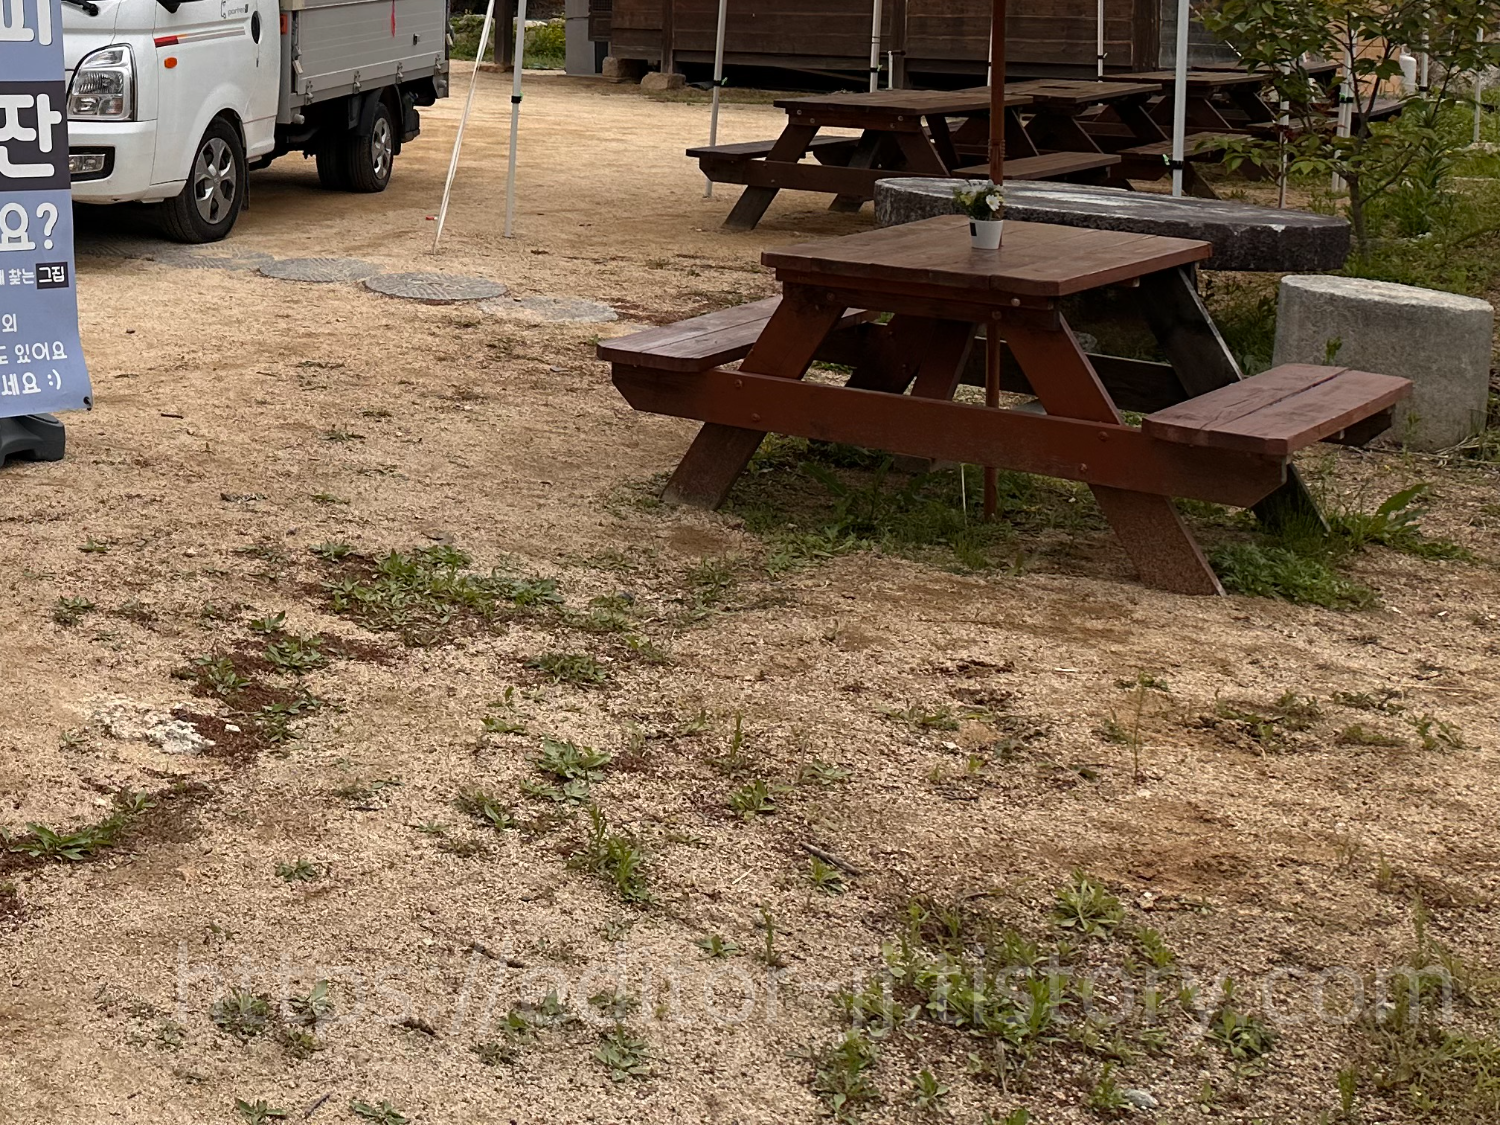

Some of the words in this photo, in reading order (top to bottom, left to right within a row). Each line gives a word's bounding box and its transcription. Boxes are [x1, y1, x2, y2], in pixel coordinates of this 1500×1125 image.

[8, 268, 35, 286] 찾는
[38, 266, 65, 283] 그집
[1, 313, 18, 333] 외
[14, 340, 68, 364] 있어요
